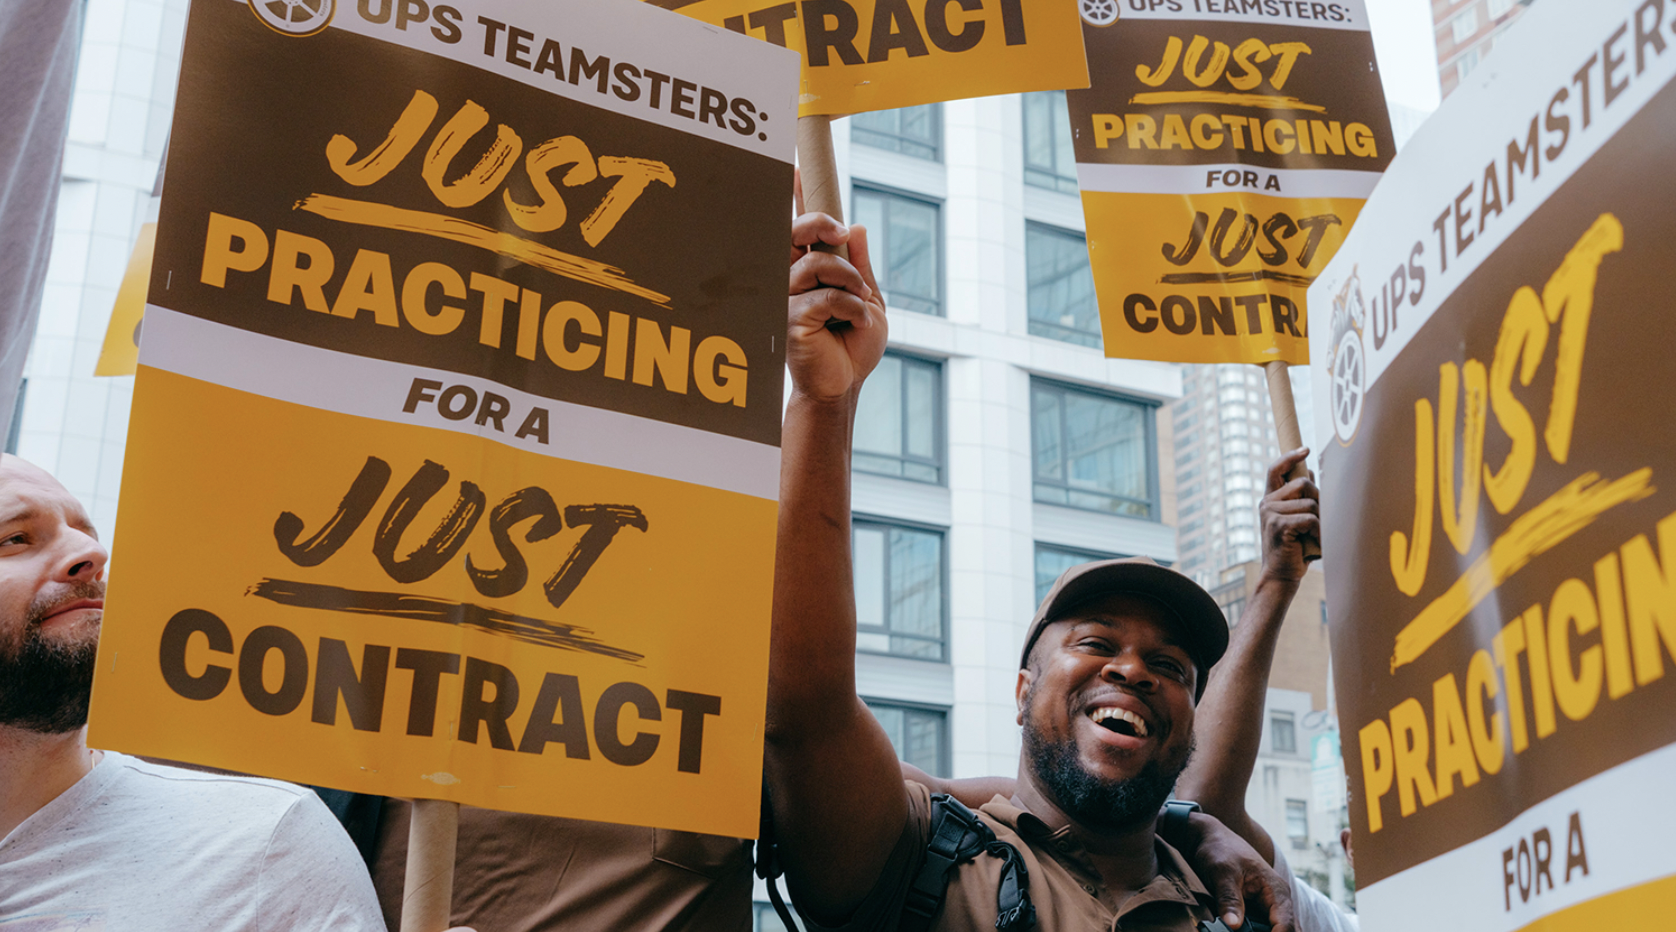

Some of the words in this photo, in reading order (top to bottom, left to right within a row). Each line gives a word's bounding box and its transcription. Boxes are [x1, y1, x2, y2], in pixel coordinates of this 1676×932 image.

[722, 0, 1028, 68] TRACT
[1191, 0, 1352, 23] TEAMSTERS:
[357, 0, 463, 45] UPS
[478, 15, 769, 142] TEAMSTERS:
[1134, 34, 1313, 91] JUST
[325, 89, 677, 248] JUST
[1092, 112, 1379, 158] PRACTICING
[1372, 241, 1426, 352] UPS
[1433, 0, 1676, 275] TEAMSTER
[1206, 170, 1259, 188] FOR
[1264, 174, 1282, 192] A
[1161, 207, 1342, 269] JUST
[200, 211, 748, 408] PRACTICING
[1123, 292, 1309, 338] CONTR
[402, 377, 511, 434] FOR
[514, 406, 550, 449] A
[1389, 212, 1625, 597] JUST
[272, 455, 649, 609] JUST
[158, 608, 722, 775] CONTRACT
[1501, 826, 1555, 913] FOR
[1564, 810, 1590, 885] A
